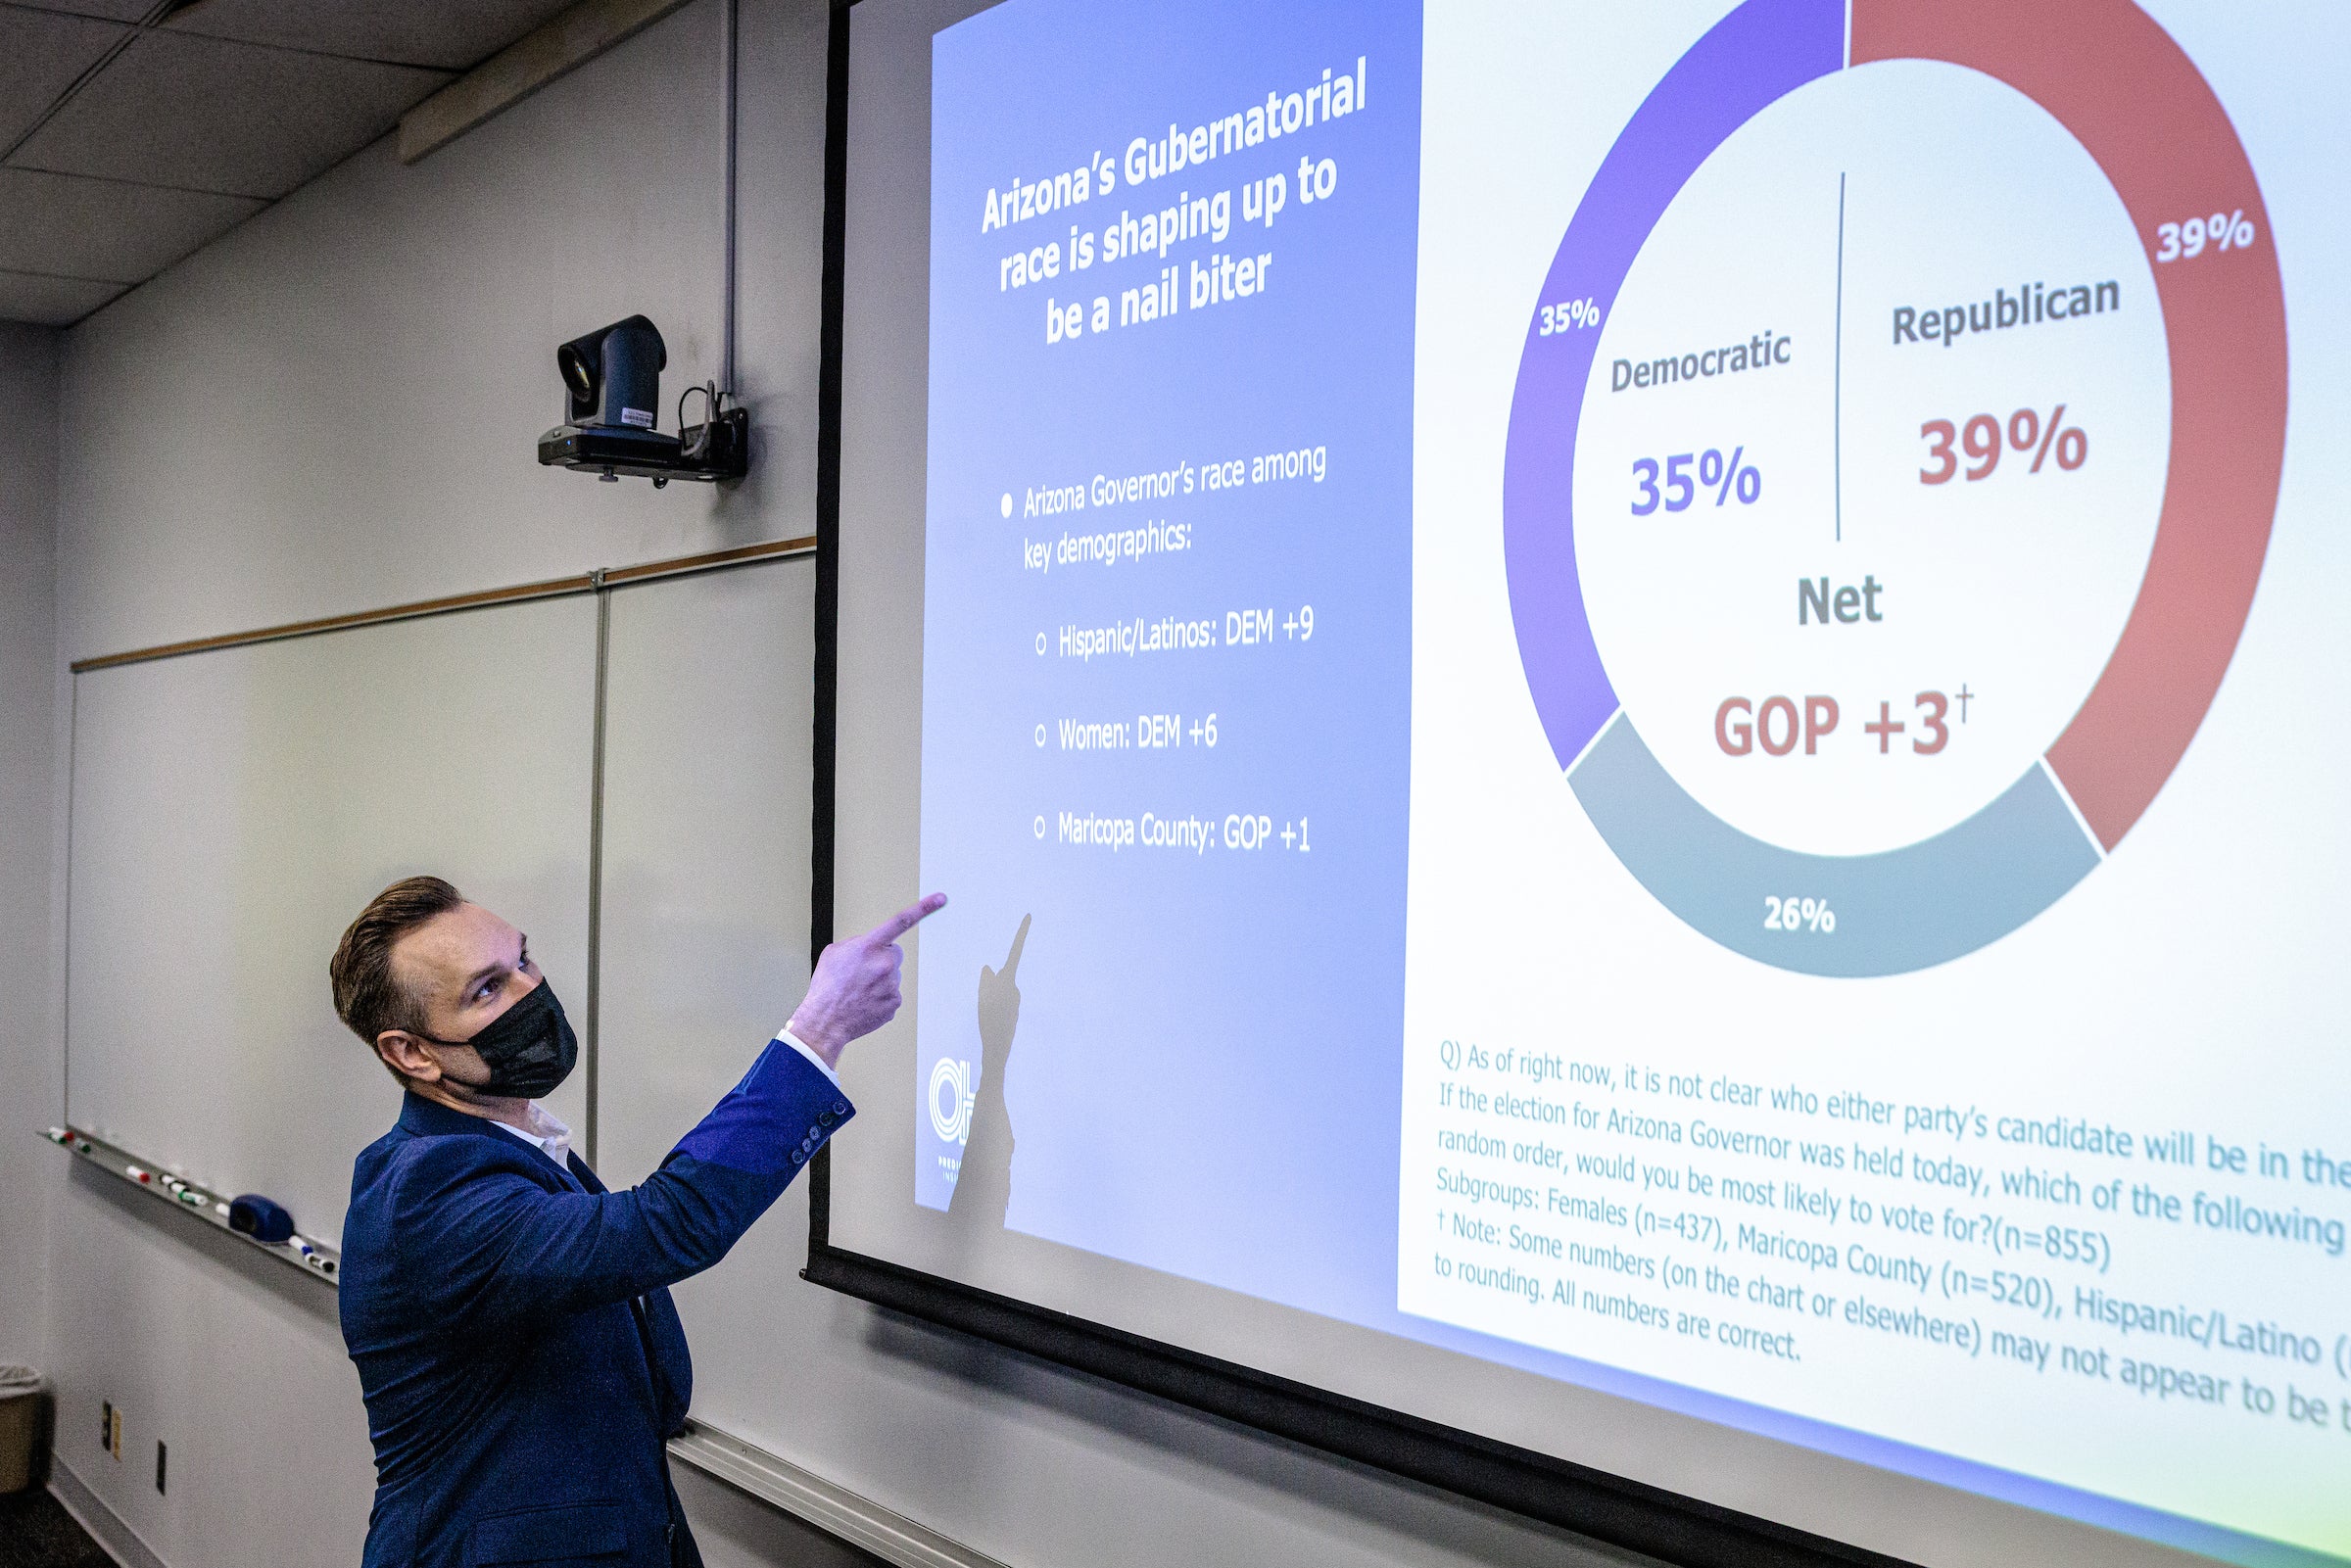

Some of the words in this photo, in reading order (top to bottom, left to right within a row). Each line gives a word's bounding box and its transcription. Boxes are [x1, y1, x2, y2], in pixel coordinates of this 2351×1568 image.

[982, 150, 1116, 233] Arizona’s
[1124, 56, 1367, 186] Gubernatorial
[1000, 242, 1060, 292] race
[1069, 225, 1094, 271] is
[1103, 190, 1230, 263] shaping
[1242, 171, 1287, 227] up
[1297, 156, 1337, 205] to
[2156, 210, 2254, 262] 39%
[1047, 298, 1082, 344] be
[1091, 295, 1110, 333] a
[1121, 265, 1178, 327] nail
[1189, 252, 1271, 309] biter
[1539, 298, 1600, 336] 35%
[1892, 279, 2120, 347] Republican
[1611, 329, 1791, 392] Democratic
[1919, 404, 2087, 486] 39%
[1024, 484, 1085, 519] Arizona
[1091, 460, 1194, 507] Governor’s
[1201, 458, 1245, 492] race
[1252, 446, 1326, 483] among
[1631, 446, 1761, 517] 35%
[1024, 538, 1053, 574] key
[1057, 519, 1192, 565] demographics:
[1059, 616, 1217, 662] Hispanic/Latinos:
[1225, 608, 1273, 645] DEM
[1282, 604, 1315, 641] +9
[1799, 575, 1883, 626] Net
[1059, 719, 1129, 750] Women:
[1138, 714, 1180, 748] DEM
[1188, 713, 1218, 748] +6
[1714, 695, 1840, 757] GOP
[1059, 812, 1134, 852] Maricopa
[1141, 812, 1215, 856] County:
[1223, 814, 1271, 850] GOP
[1280, 817, 1311, 852] +1
[1764, 895, 1836, 933] 26%
[1440, 1040, 1462, 1071] Q)
[1467, 1044, 1489, 1069] As
[1496, 1047, 1514, 1072] of
[1520, 1051, 1563, 1083] right
[1569, 1061, 1616, 1093] now,
[1625, 1063, 1638, 1090] it
[1646, 1066, 1660, 1093] is
[1668, 1073, 1703, 1100] not
[1710, 1074, 1763, 1107] clear
[1770, 1083, 1818, 1116] who
[1827, 1090, 1895, 1124] either
[1904, 1104, 1988, 1140] party’s
[1997, 1116, 2134, 1158] candidate
[2143, 1131, 2194, 1165] will
[2207, 1135, 2246, 1172] be
[2259, 1143, 2288, 1179] in
[2302, 1150, 2351, 1189] the
[1438, 1129, 1507, 1160] random
[1513, 1141, 1568, 1175] order,
[1576, 1153, 1635, 1182] would
[1643, 1164, 1679, 1191] you
[1688, 1165, 1713, 1196] be
[1722, 1177, 1776, 1208] most
[1784, 1181, 1842, 1225] likely
[1849, 1194, 1873, 1224] to
[1882, 1201, 1934, 1237] vote
[1439, 1082, 1454, 1107] If
[1459, 1085, 1487, 1113] the
[1494, 1091, 1565, 1124] election
[1573, 1101, 1600, 1129] for
[1607, 1108, 1682, 1144] Arizona
[1691, 1119, 1792, 1160] Governor
[1799, 1140, 1845, 1169] was
[1854, 1142, 1903, 1178] held
[1913, 1151, 1991, 1198] today,
[2001, 1166, 2082, 1207] which
[2092, 1178, 2124, 1212] of
[2132, 1183, 2182, 1221] the
[2193, 1192, 2345, 1256] following
[1436, 1166, 1539, 1212] Subgroups:
[1548, 1187, 1627, 1227] Females
[1635, 1203, 1729, 1253] (n=437),
[1738, 1222, 1838, 1271] Maricopa
[1847, 1244, 1932, 1292] County
[1941, 1260, 2063, 1321] (n=520),
[2074, 1286, 2321, 1364] Hispanic/Latino
[1435, 1252, 1452, 1277] to
[1458, 1261, 1545, 1305] rounding.
[1552, 1278, 1575, 1307] All
[1583, 1289, 1669, 1330] numbers
[1677, 1310, 1710, 1339] are
[1718, 1321, 1800, 1362] correct.
[1453, 1212, 1501, 1245] Note:
[1510, 1224, 1562, 1259] Some
[1569, 1242, 1655, 1279] numbers
[1662, 1255, 1698, 1289] (on
[1705, 1265, 1740, 1297] the
[1748, 1275, 1804, 1312] chart
[1812, 1293, 1837, 1317] or
[1845, 1295, 1982, 1356] elsewhere)
[1991, 1329, 2050, 1372] may
[2061, 1342, 2110, 1379] not
[2121, 1356, 2231, 1403] appear
[2241, 1377, 2275, 1414] to
[2287, 1383, 2329, 1427] be
